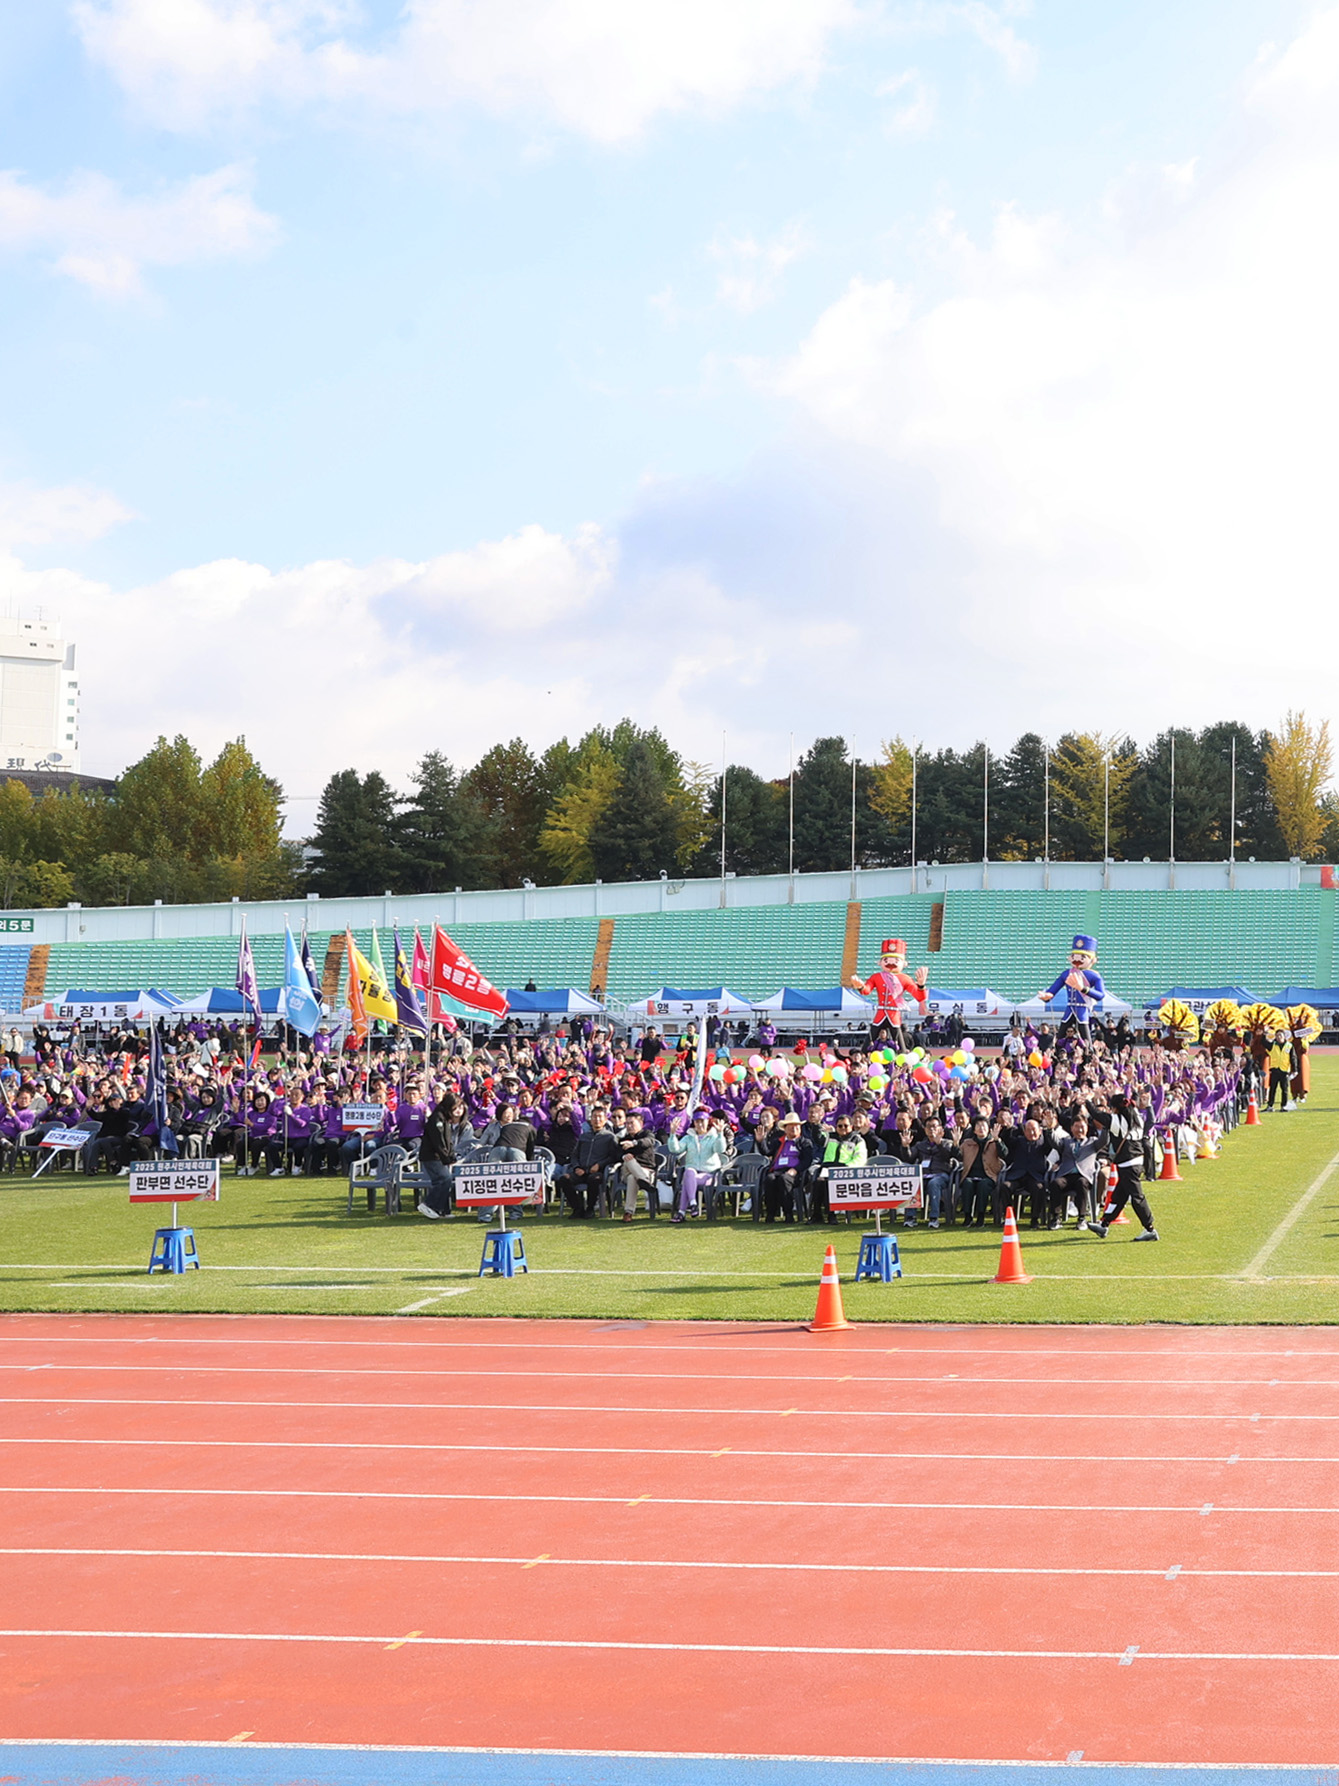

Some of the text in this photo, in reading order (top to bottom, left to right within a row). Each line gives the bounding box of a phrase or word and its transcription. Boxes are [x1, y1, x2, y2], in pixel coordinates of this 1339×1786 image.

[134, 1161, 212, 1172] 2025 원주시민체육대회
[460, 1164, 538, 1175] 2025 원주시민체육대회
[833, 1167, 915, 1178] 2025 원주시민체육대회
[136, 1174, 209, 1191] 판부면 선수단
[462, 1178, 536, 1195] 지정면 선수단
[836, 1181, 913, 1198] 문막읍 선수단
